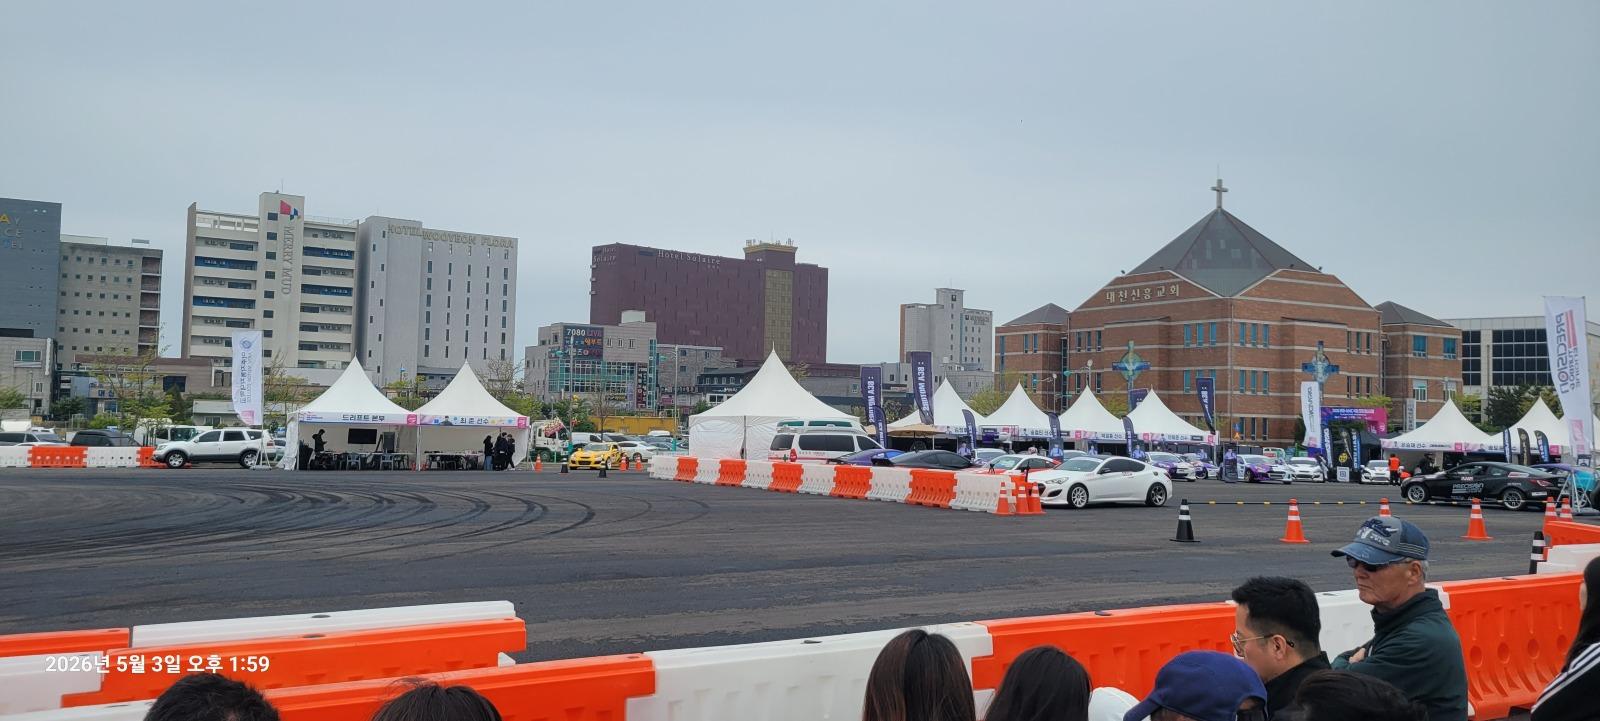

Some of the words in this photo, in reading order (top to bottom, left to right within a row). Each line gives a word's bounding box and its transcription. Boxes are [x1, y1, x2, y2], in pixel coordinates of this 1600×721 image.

[387, 224, 421, 237] HOTEL
[658, 249, 683, 259] Hotel
[686, 254, 721, 265] Solaire
[1106, 284, 1180, 303] 대천신흥교회
[566, 328, 586, 337] 7080
